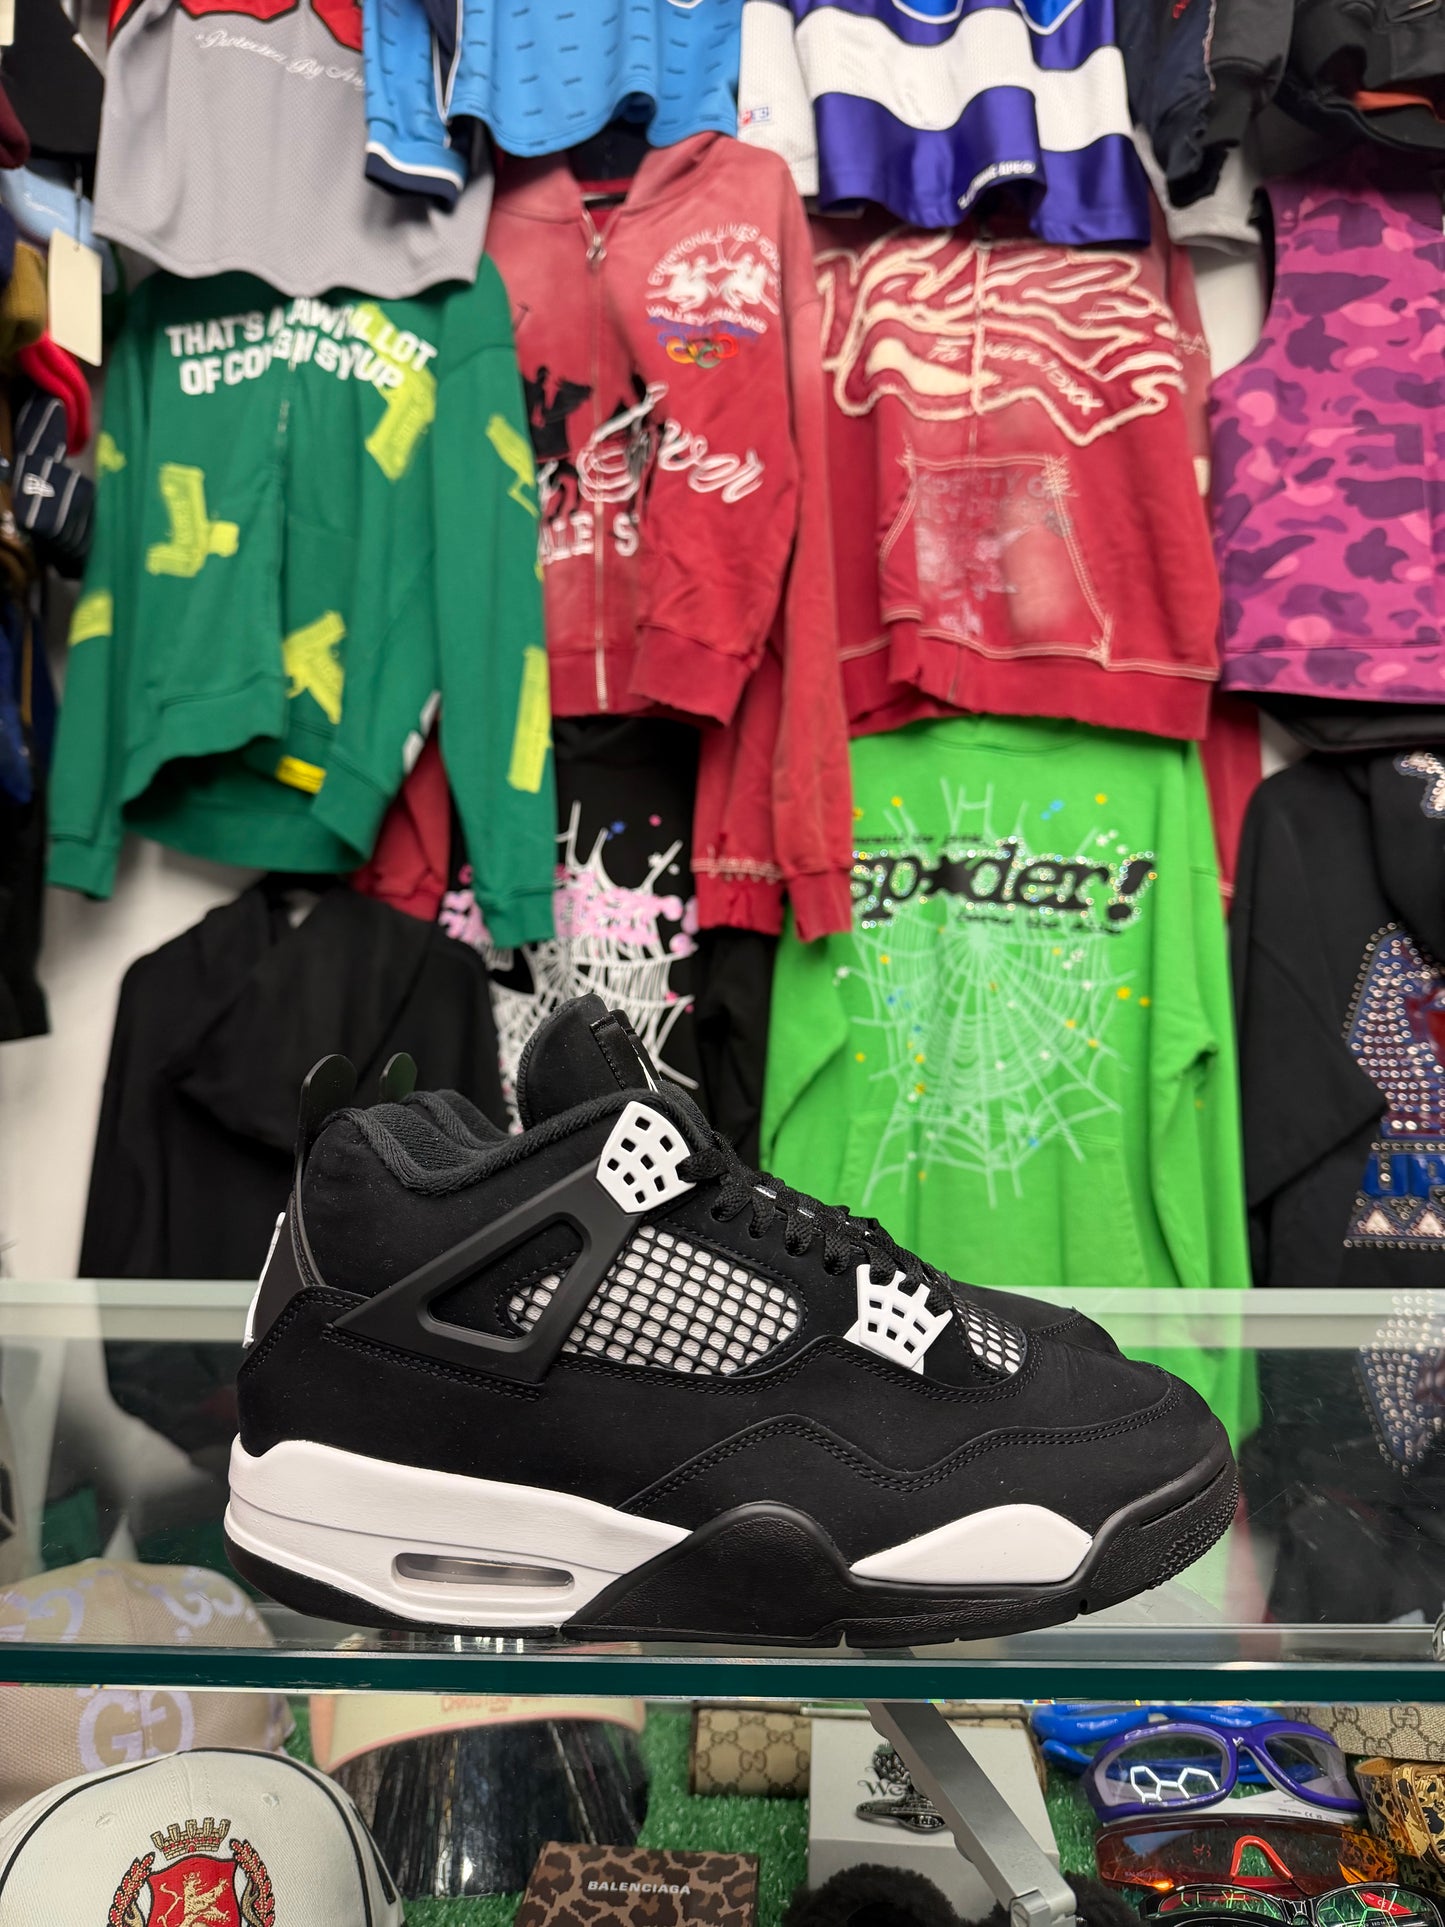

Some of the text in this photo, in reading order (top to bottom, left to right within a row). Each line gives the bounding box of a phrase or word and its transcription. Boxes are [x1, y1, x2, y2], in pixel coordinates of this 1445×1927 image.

[165, 311, 265, 357] THAT'S
[372, 330, 438, 372] LOT
[179, 357, 221, 395] OF
[587, 1880, 691, 1895] BALENCIAGA
